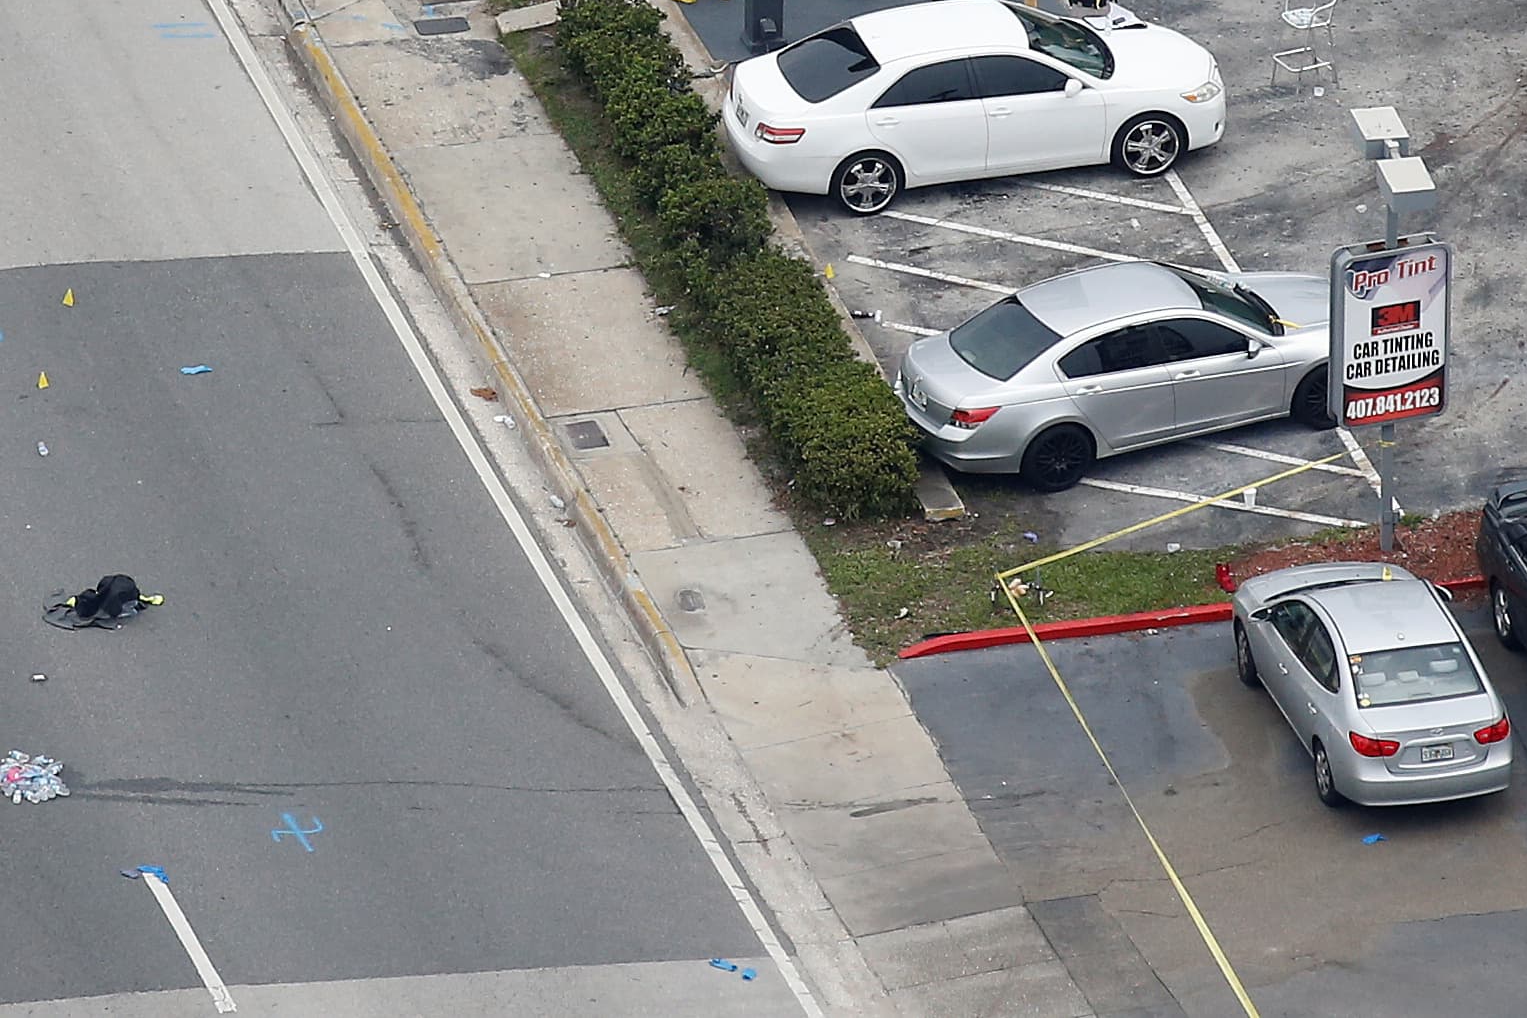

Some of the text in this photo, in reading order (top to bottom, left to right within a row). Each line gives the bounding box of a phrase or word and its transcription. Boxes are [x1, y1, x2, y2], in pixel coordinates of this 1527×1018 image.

[1352, 255, 1437, 293] Pro Tint
[1377, 303, 1417, 327] 3M
[1353, 332, 1433, 360] CAR TINTING
[1346, 350, 1440, 380] CAR DETAILING
[1346, 388, 1440, 420] 407.841.2123
